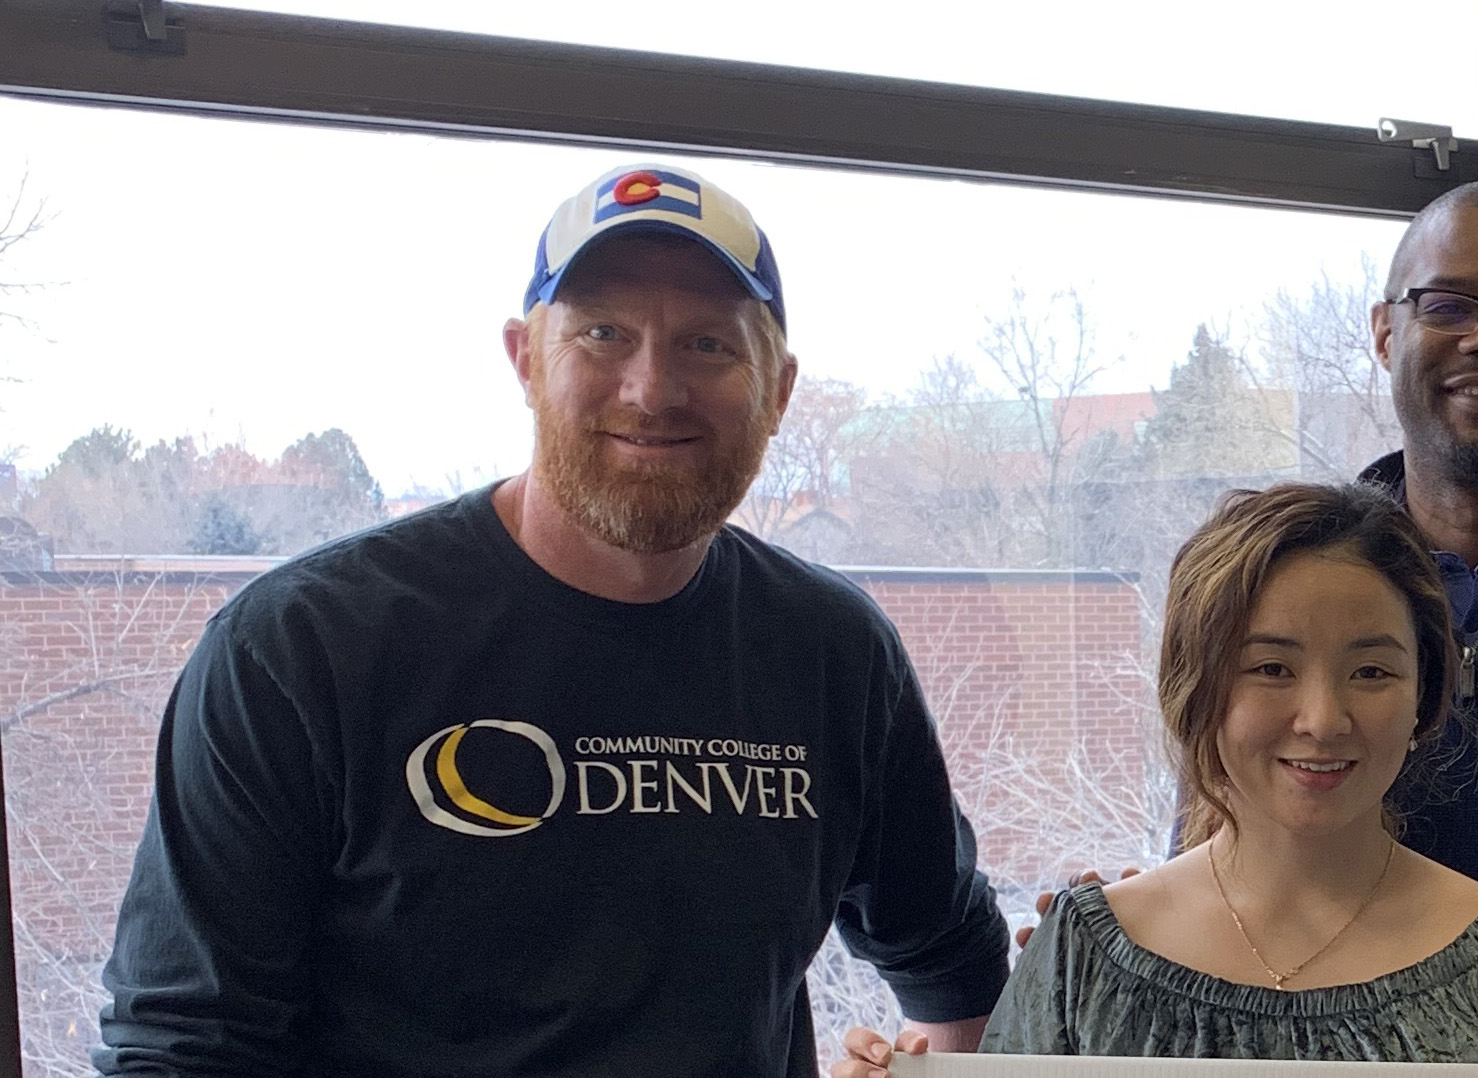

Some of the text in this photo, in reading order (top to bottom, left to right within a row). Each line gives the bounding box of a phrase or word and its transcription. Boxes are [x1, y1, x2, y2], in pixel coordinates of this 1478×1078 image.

[575, 736, 808, 762] COMMUNITY COLLEGE OF
[574, 759, 818, 819] DENVER
